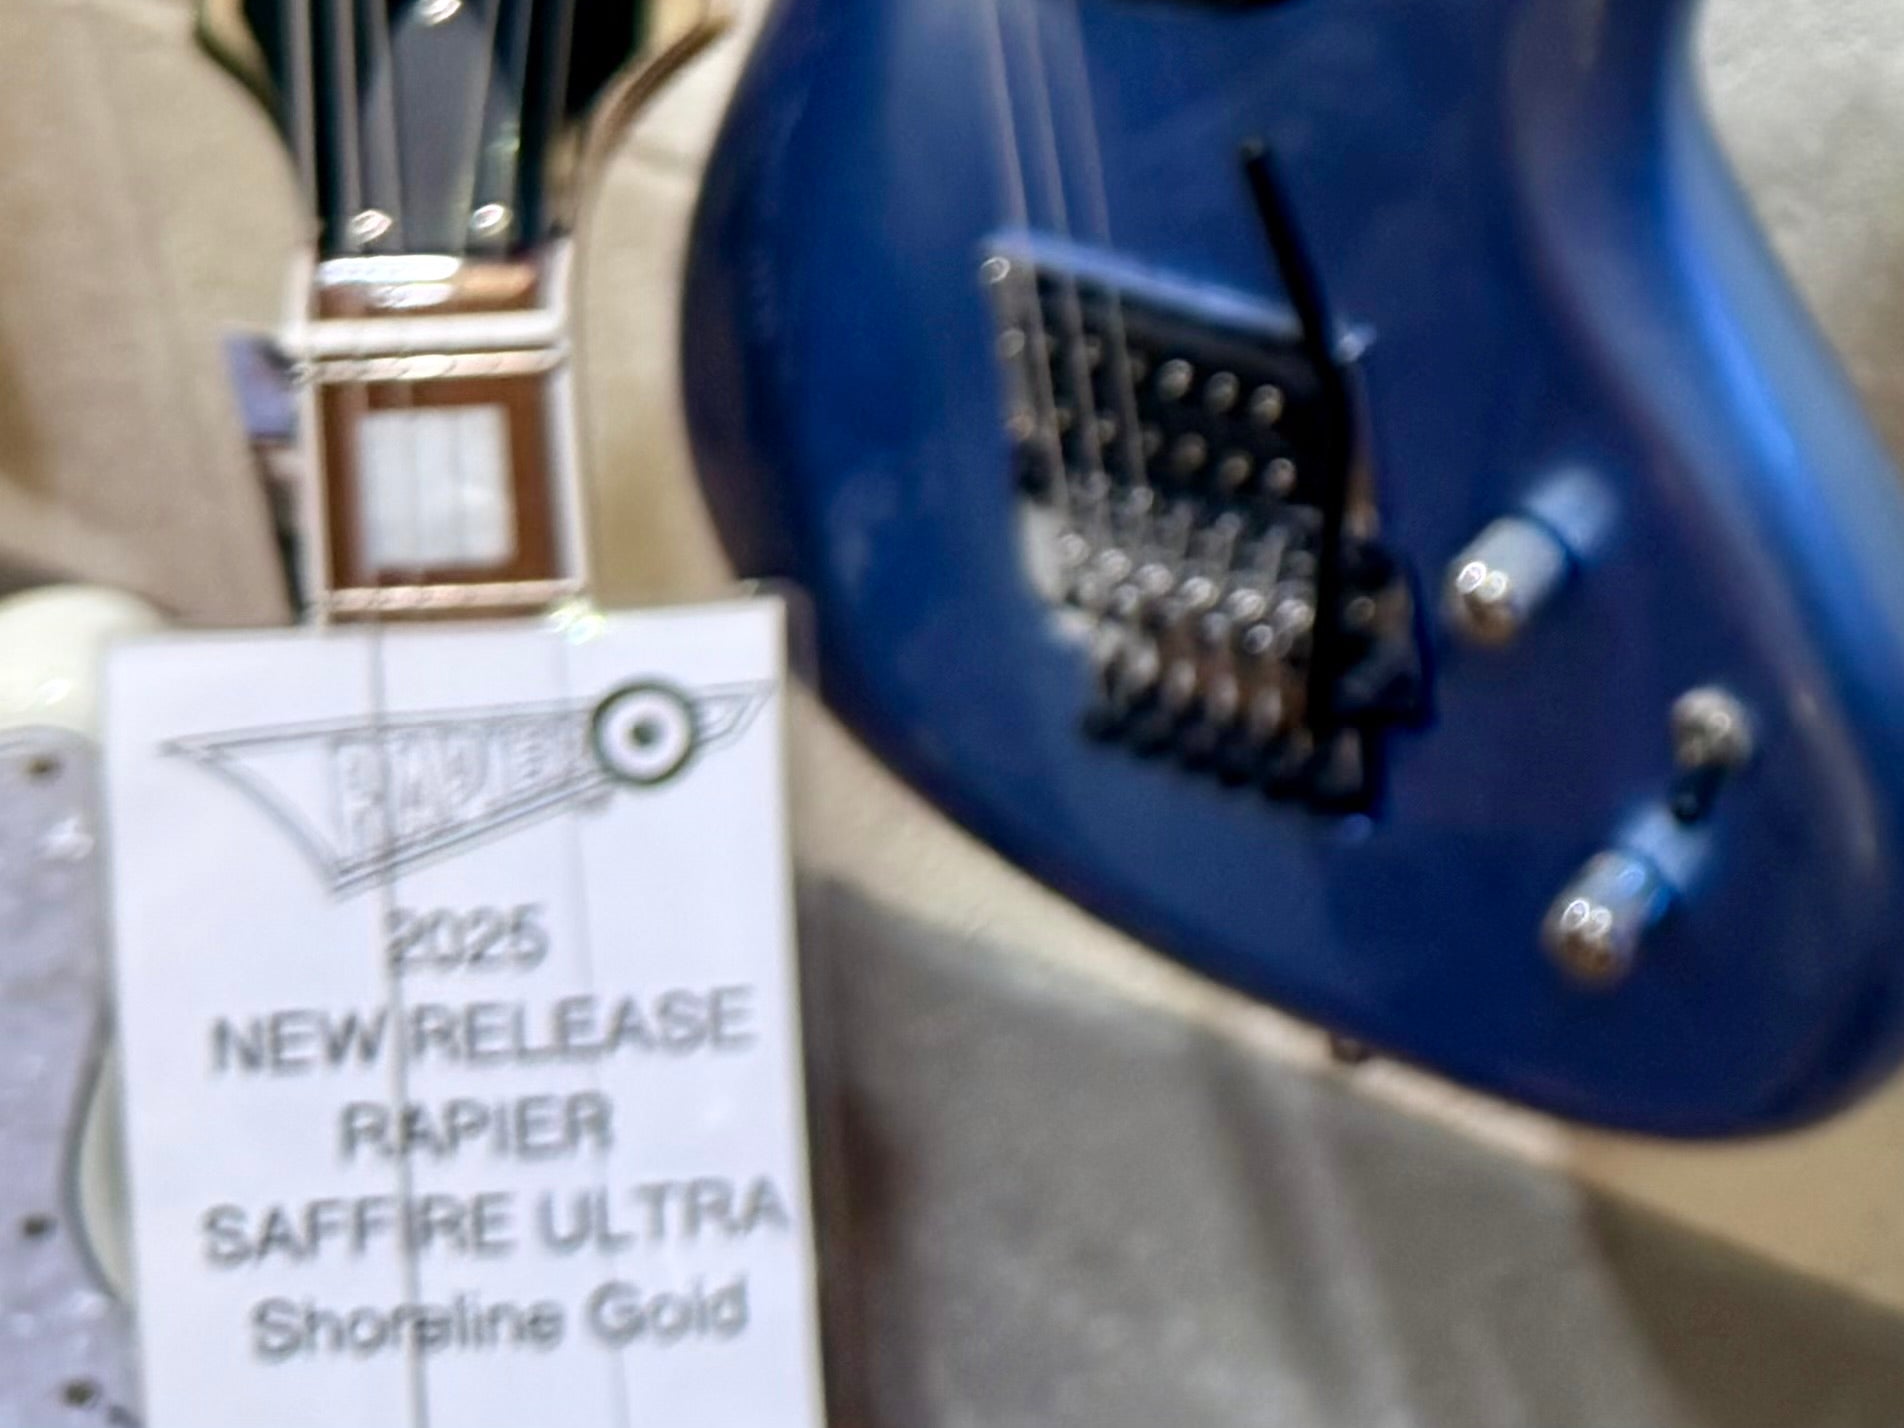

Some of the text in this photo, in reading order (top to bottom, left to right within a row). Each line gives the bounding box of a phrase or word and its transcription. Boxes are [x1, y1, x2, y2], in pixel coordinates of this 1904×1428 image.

[385, 901, 550, 973] 2025
[210, 984, 758, 1077] NEW RELEASE
[338, 1089, 615, 1162] RAPIER
[201, 1174, 788, 1270] SAFFIRE ULTRA
[252, 1271, 750, 1365] Shoreline Gold
